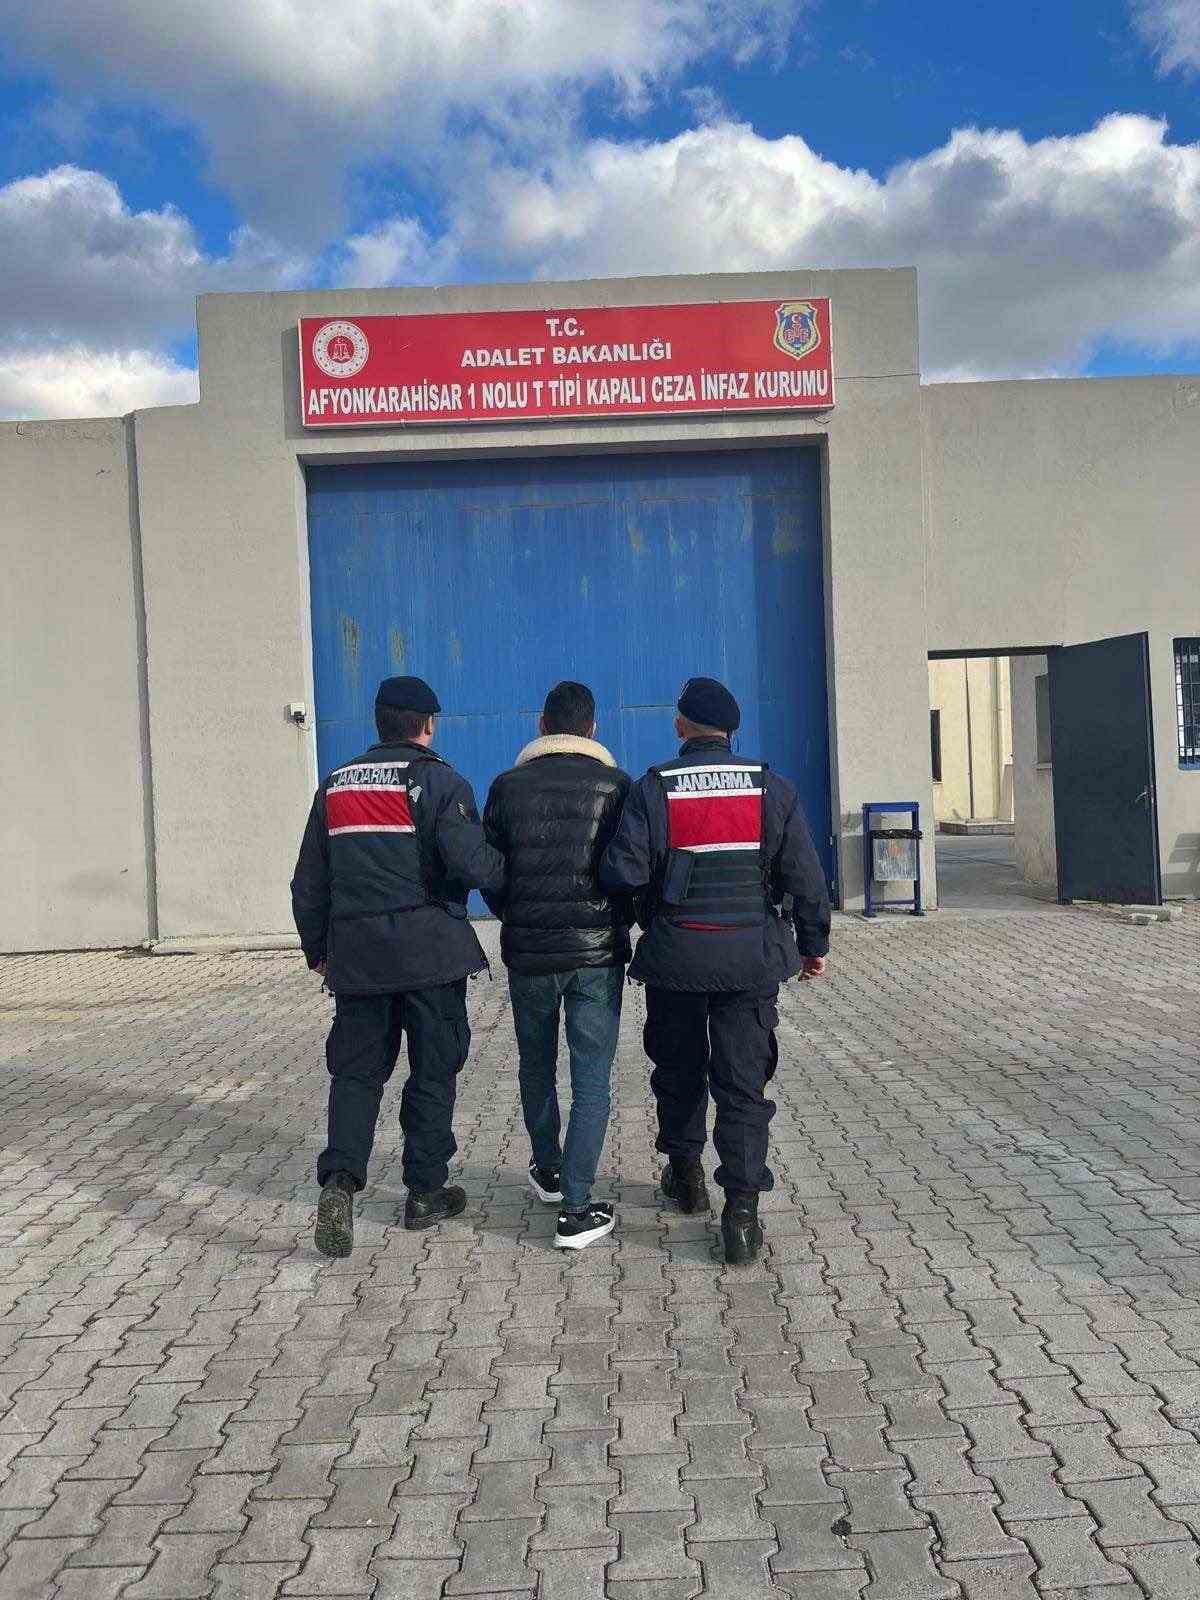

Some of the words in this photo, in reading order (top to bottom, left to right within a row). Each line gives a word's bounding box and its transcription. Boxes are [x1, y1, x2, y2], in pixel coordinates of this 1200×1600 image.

[546, 318, 585, 337] T.C.
[461, 347, 545, 368] ADALET
[552, 338, 672, 365] BAKANLIĞI
[308, 379, 463, 415] AFYONKARAHİSAR
[468, 383, 476, 410] 1
[482, 381, 528, 409] NOLU
[533, 381, 543, 407] T
[548, 374, 581, 407] TİPİ
[587, 376, 646, 405] KAPALI
[651, 374, 697, 403] CEZA
[701, 368, 750, 401] İNFAZ
[754, 369, 828, 399] KURUMU
[334, 768, 400, 787] JANDARMA
[674, 772, 753, 792] JANDARMA
